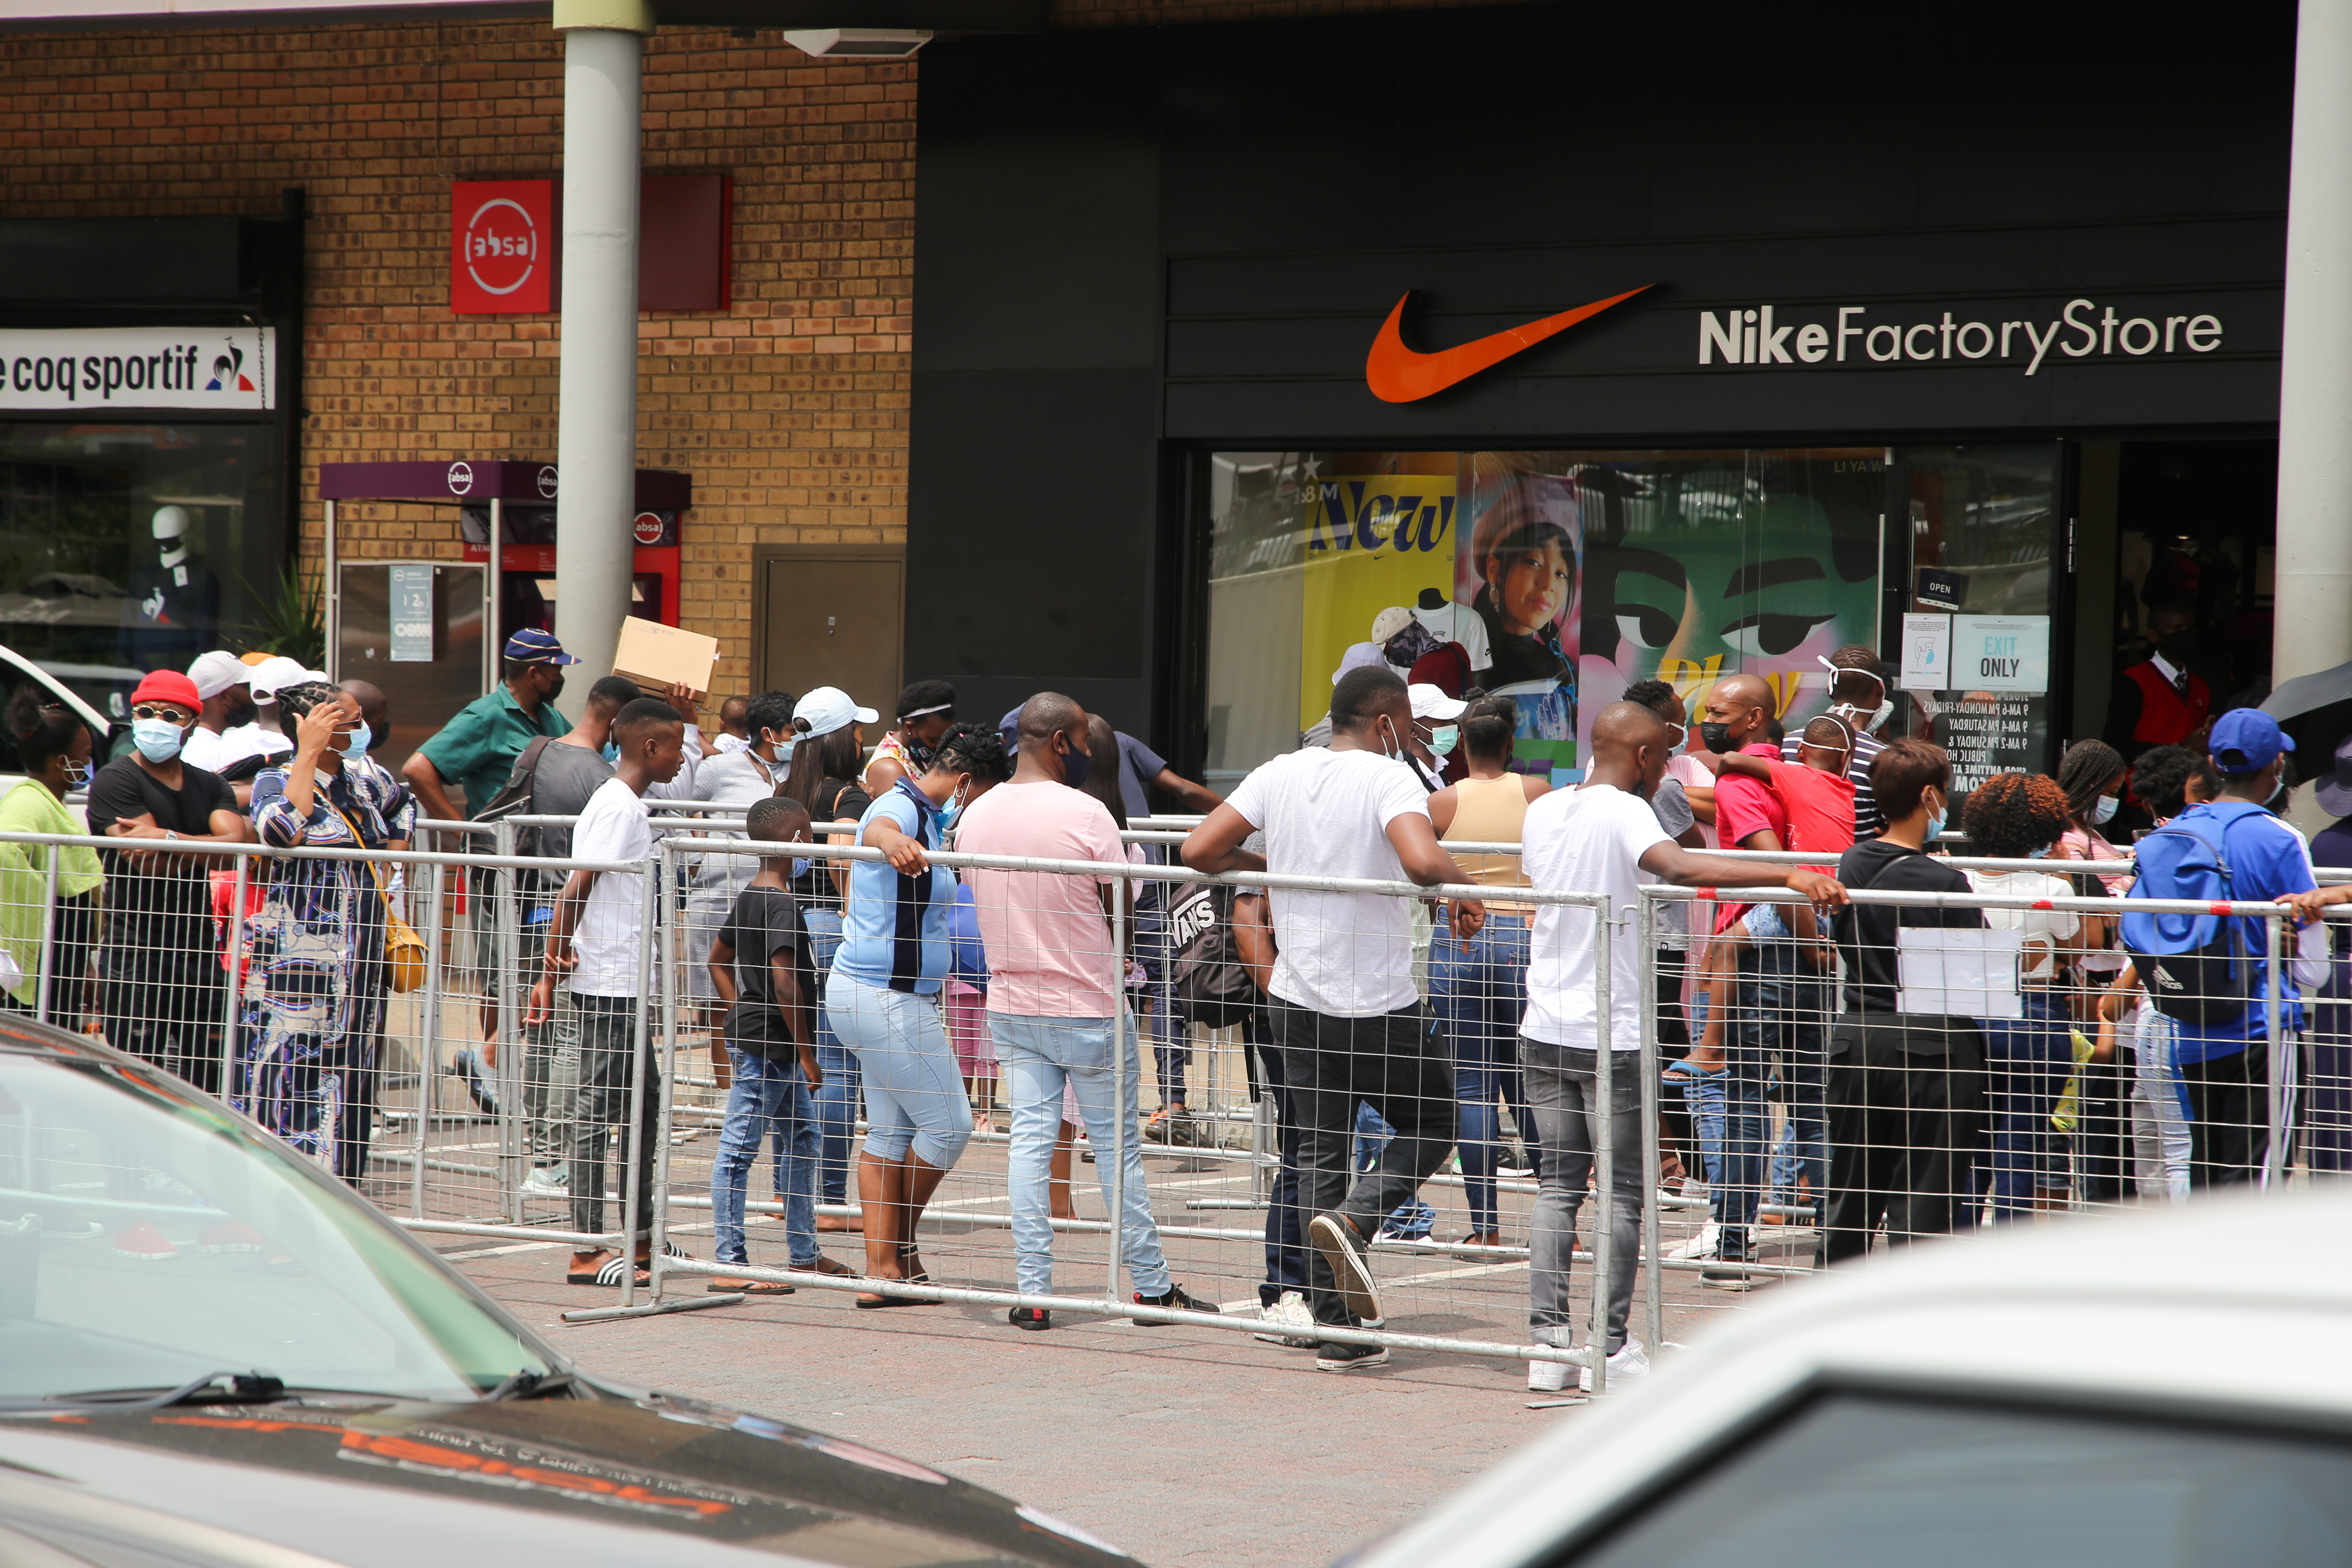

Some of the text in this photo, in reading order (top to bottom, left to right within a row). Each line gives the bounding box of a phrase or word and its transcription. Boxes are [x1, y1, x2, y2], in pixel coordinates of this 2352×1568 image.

[13, 357, 75, 401] coq
[82, 345, 198, 399] sportif
[451, 472, 469, 482] absa
[541, 475, 557, 486] absa
[1308, 481, 1456, 552] New
[636, 522, 659, 532] absa
[1930, 582, 1951, 594] OPEN
[1984, 636, 2018, 656] EXIT
[1980, 657, 2020, 678] ONLY
[1661, 653, 1803, 726] Ply
[1167, 889, 1216, 949] VANS
